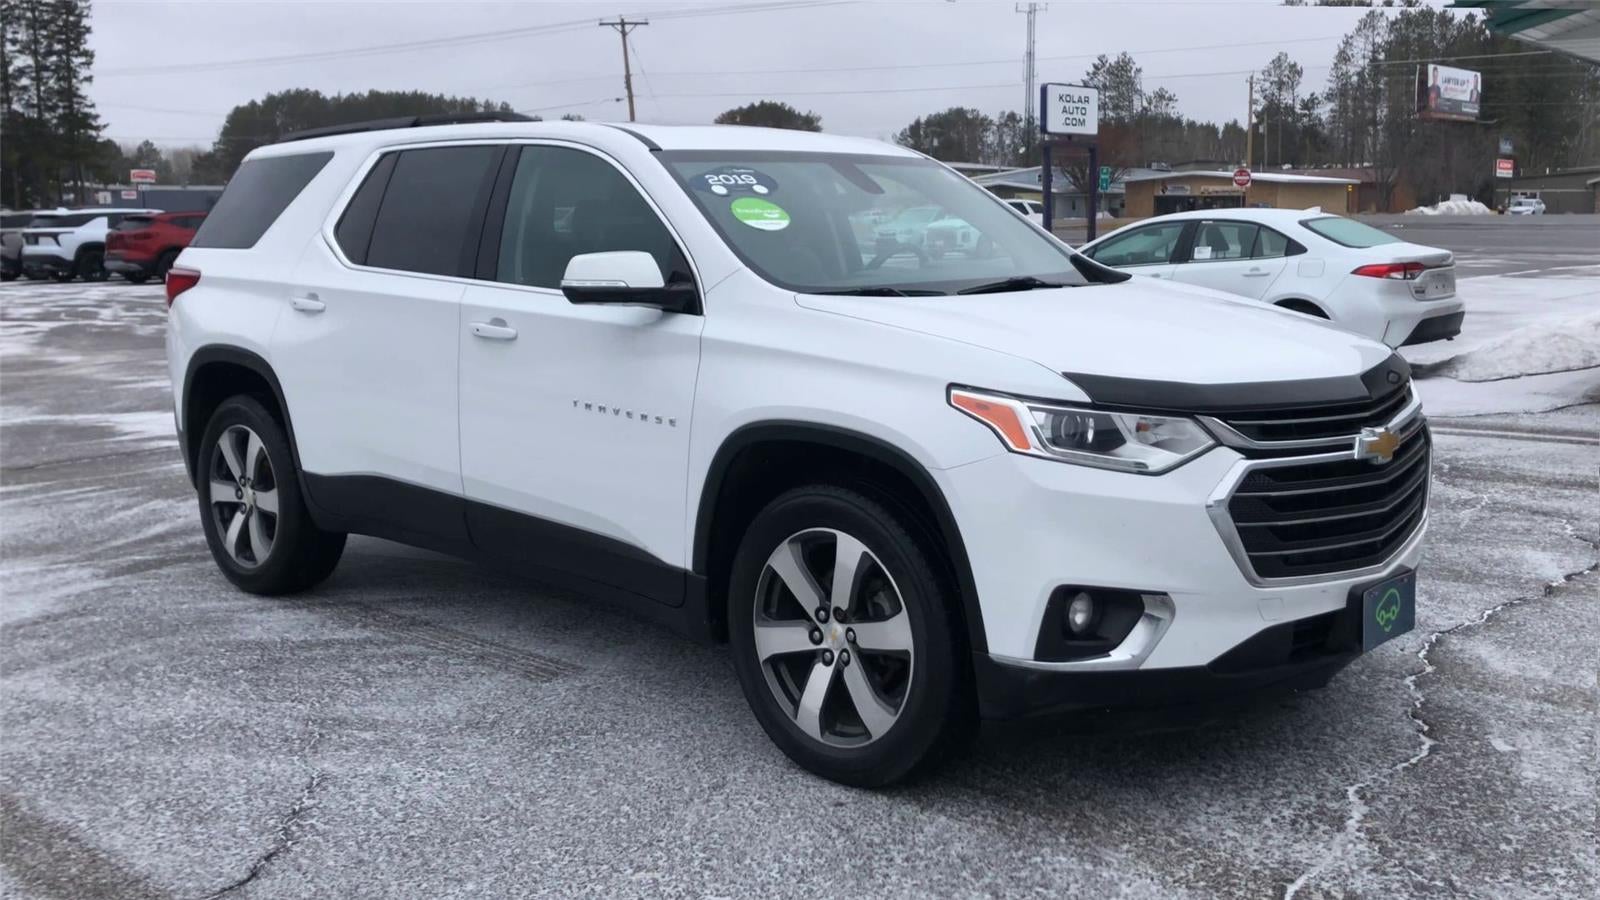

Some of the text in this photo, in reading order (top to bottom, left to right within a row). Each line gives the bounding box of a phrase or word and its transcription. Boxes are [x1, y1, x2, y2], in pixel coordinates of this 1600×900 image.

[1058, 93, 1090, 104] KOLAR
[1061, 105, 1087, 116] AUTO
[1062, 116, 1086, 127] .COM
[704, 174, 757, 185] 2019
[573, 399, 677, 427] TRAVERSE
